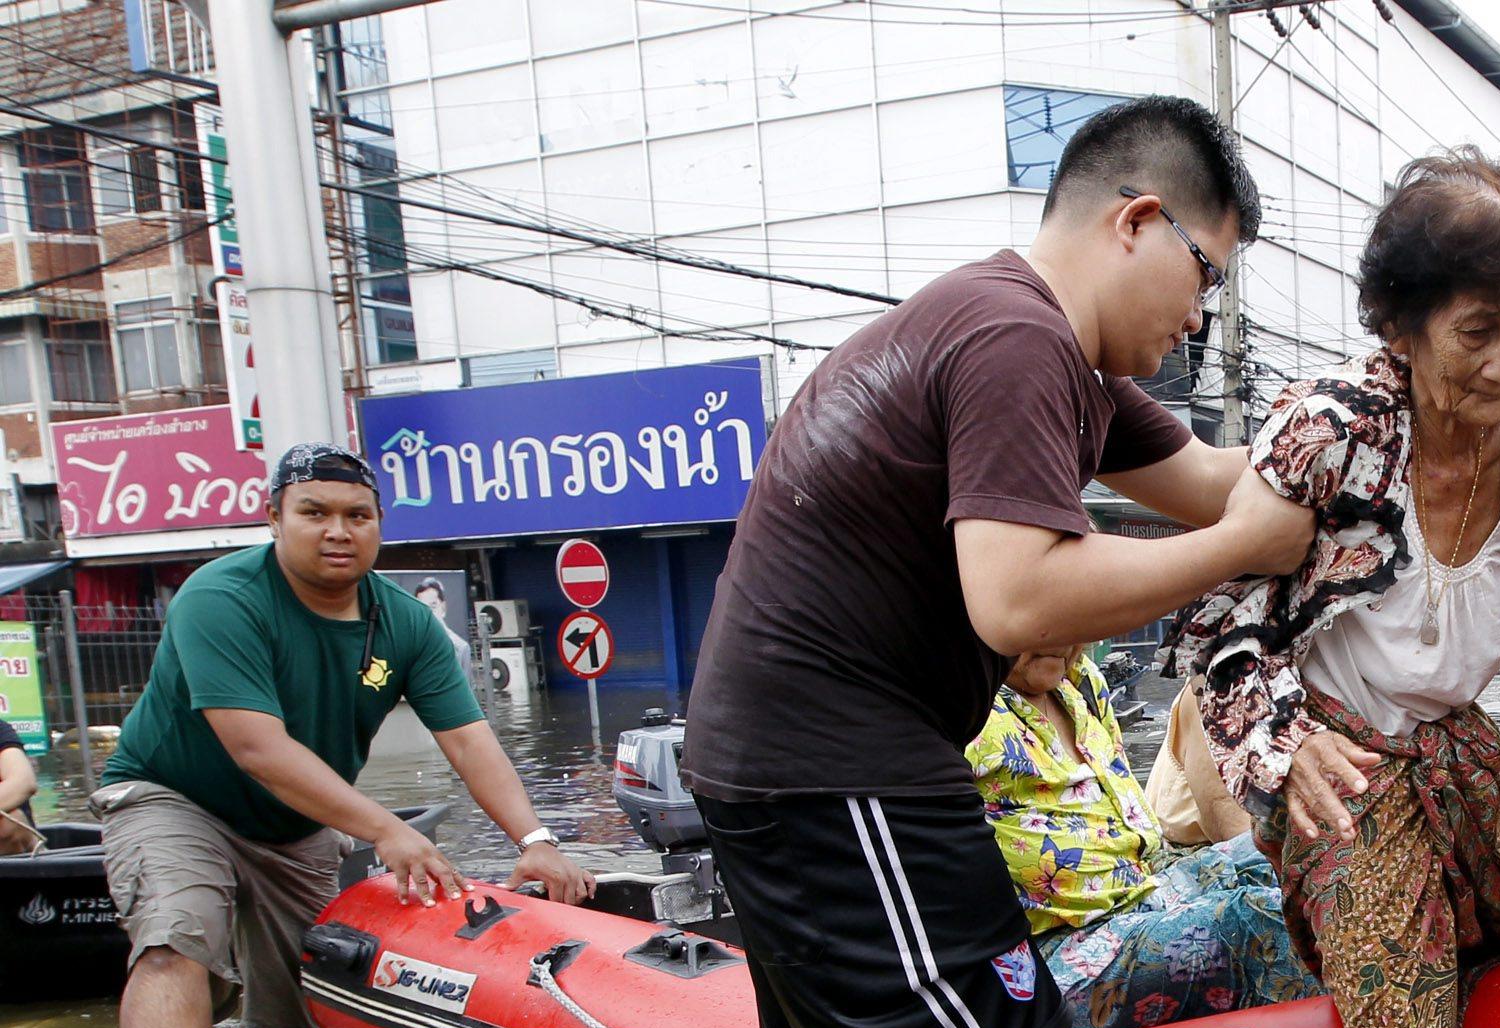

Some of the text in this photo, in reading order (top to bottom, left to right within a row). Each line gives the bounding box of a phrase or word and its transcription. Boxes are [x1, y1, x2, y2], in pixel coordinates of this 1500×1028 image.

[380, 390, 754, 507] บ้านกรองน้ำ
